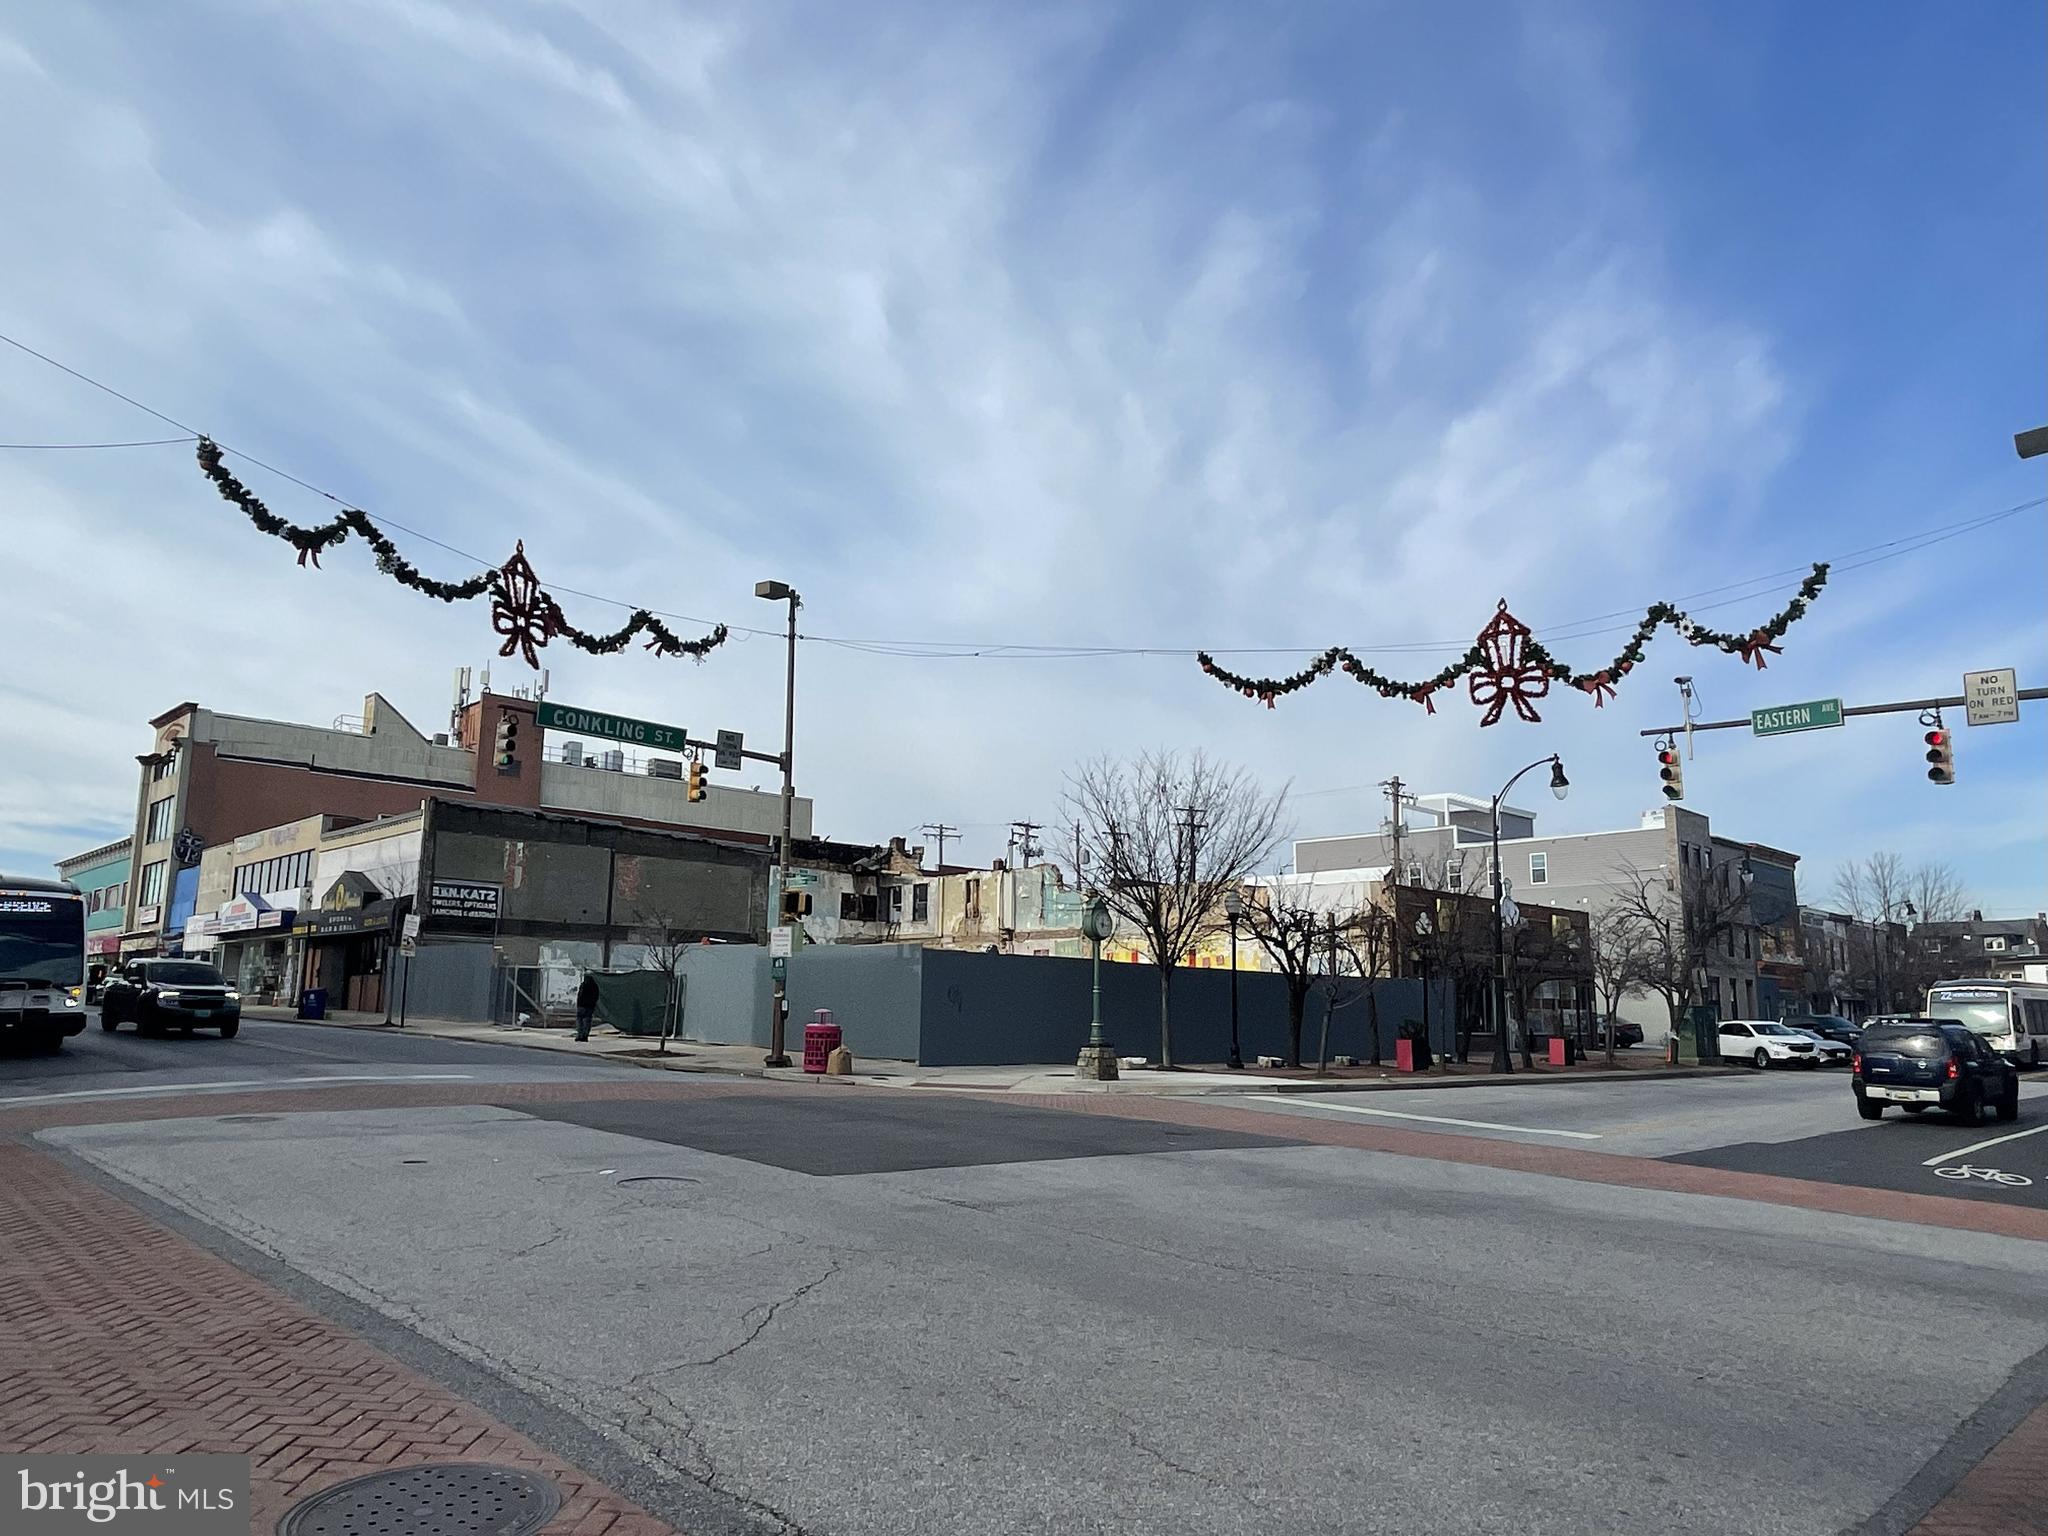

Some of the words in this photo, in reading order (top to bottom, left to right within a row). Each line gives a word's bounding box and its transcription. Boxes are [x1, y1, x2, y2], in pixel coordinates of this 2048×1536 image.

[1980, 675, 1998, 684] NO
[1976, 686, 2005, 696] TURN
[1969, 700, 1984, 709] ON
[1992, 696, 2014, 706] RED
[1756, 708, 1811, 729] EASTERN
[1821, 702, 1835, 713] AVE
[553, 709, 645, 740] CONKLING
[654, 729, 675, 744] ST.
[1940, 991, 1953, 1000] 22
